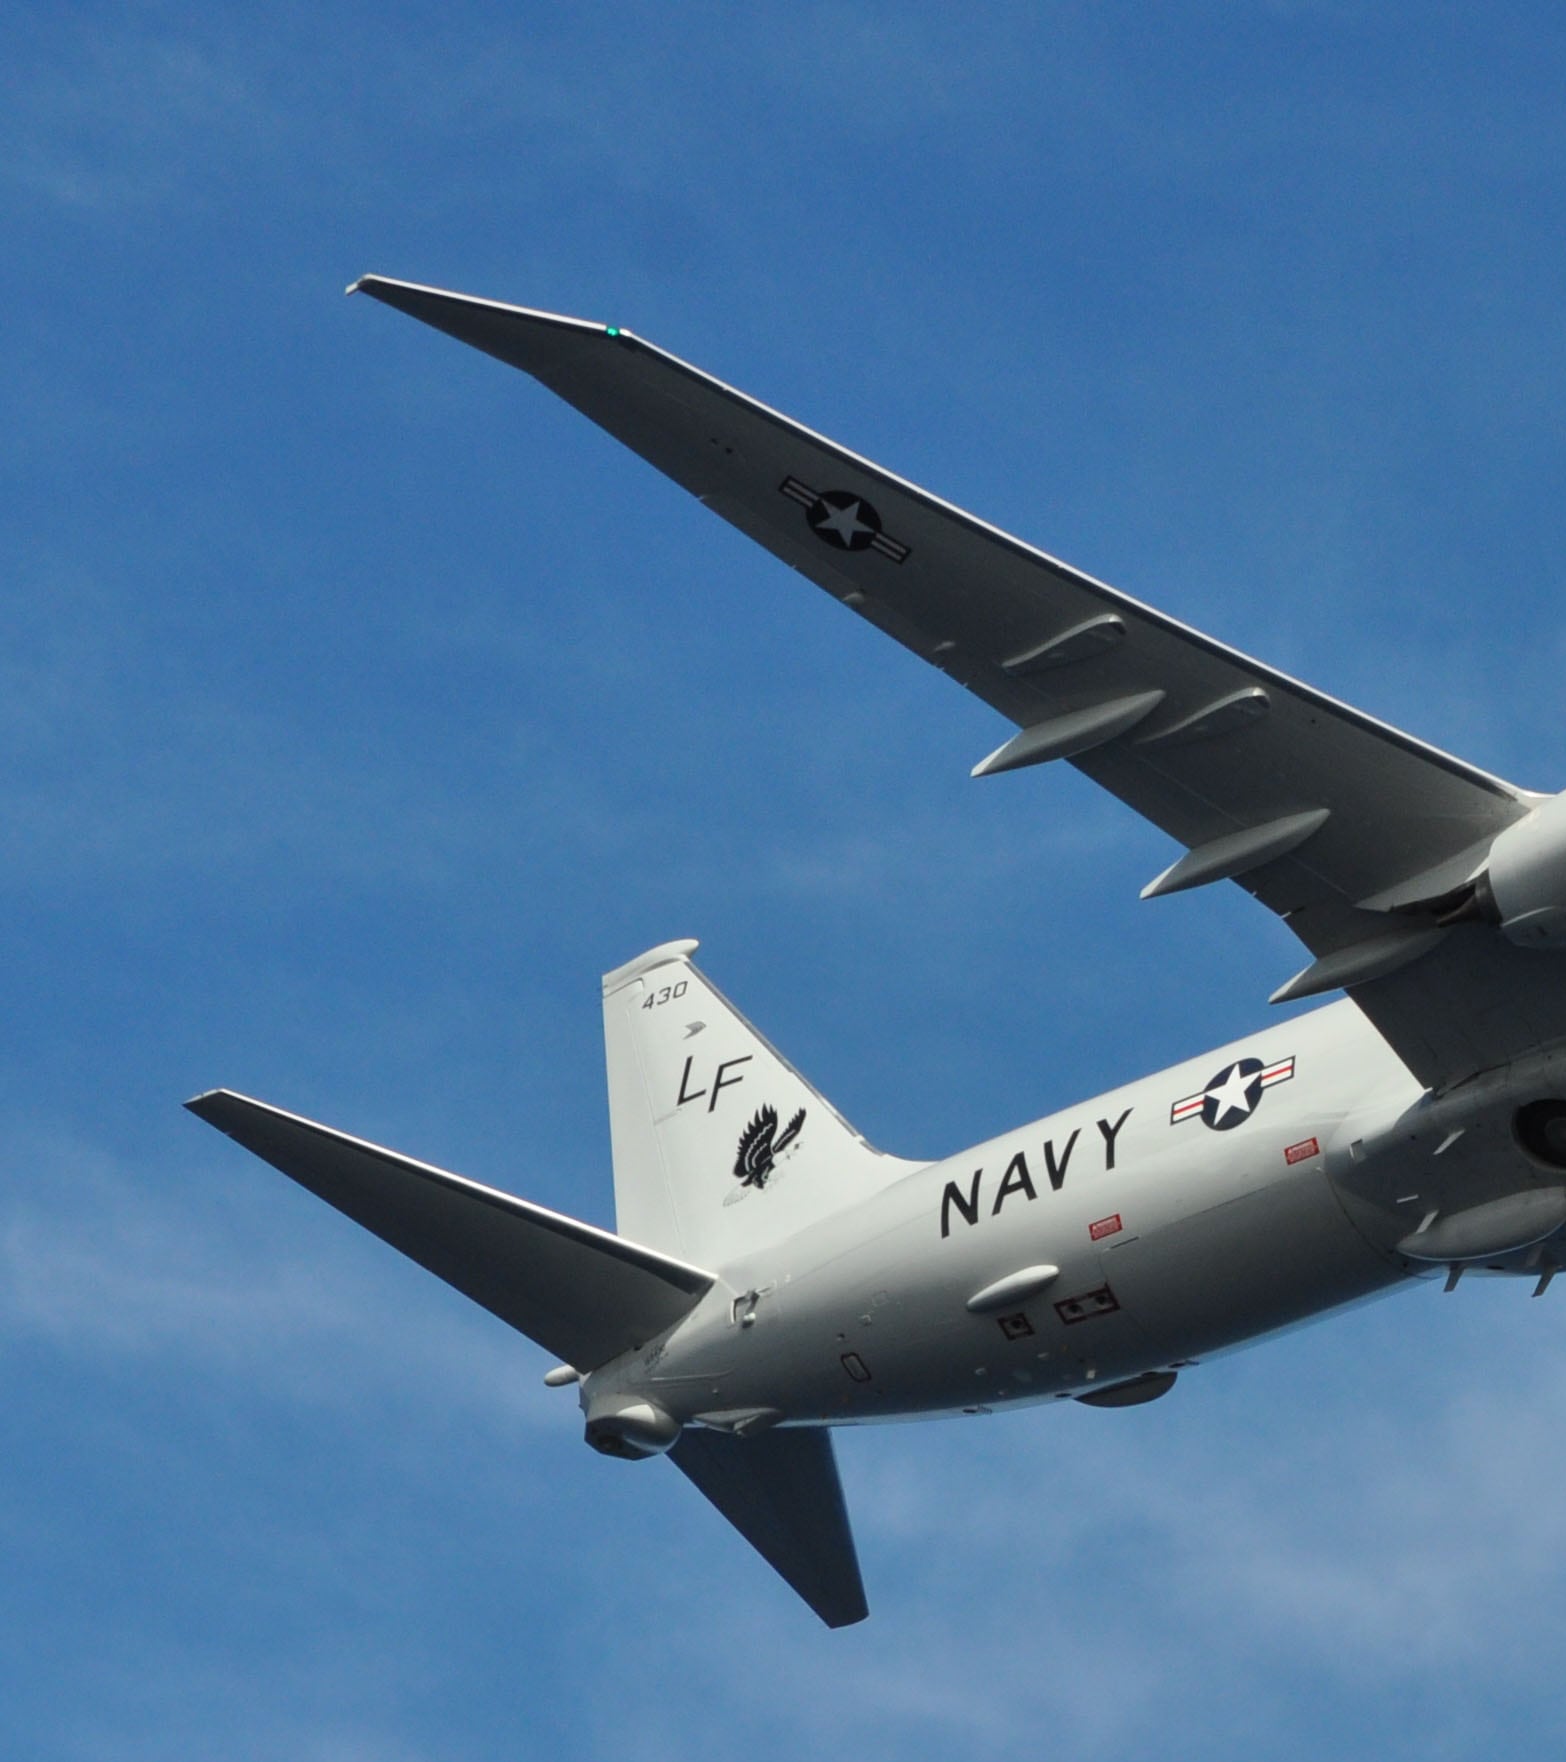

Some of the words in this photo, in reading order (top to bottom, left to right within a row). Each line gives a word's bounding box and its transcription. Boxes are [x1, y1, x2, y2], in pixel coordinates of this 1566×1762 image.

[642, 980, 688, 1010] 430
[677, 1055, 753, 1113] LF
[941, 1107, 1134, 1239] NAVY
